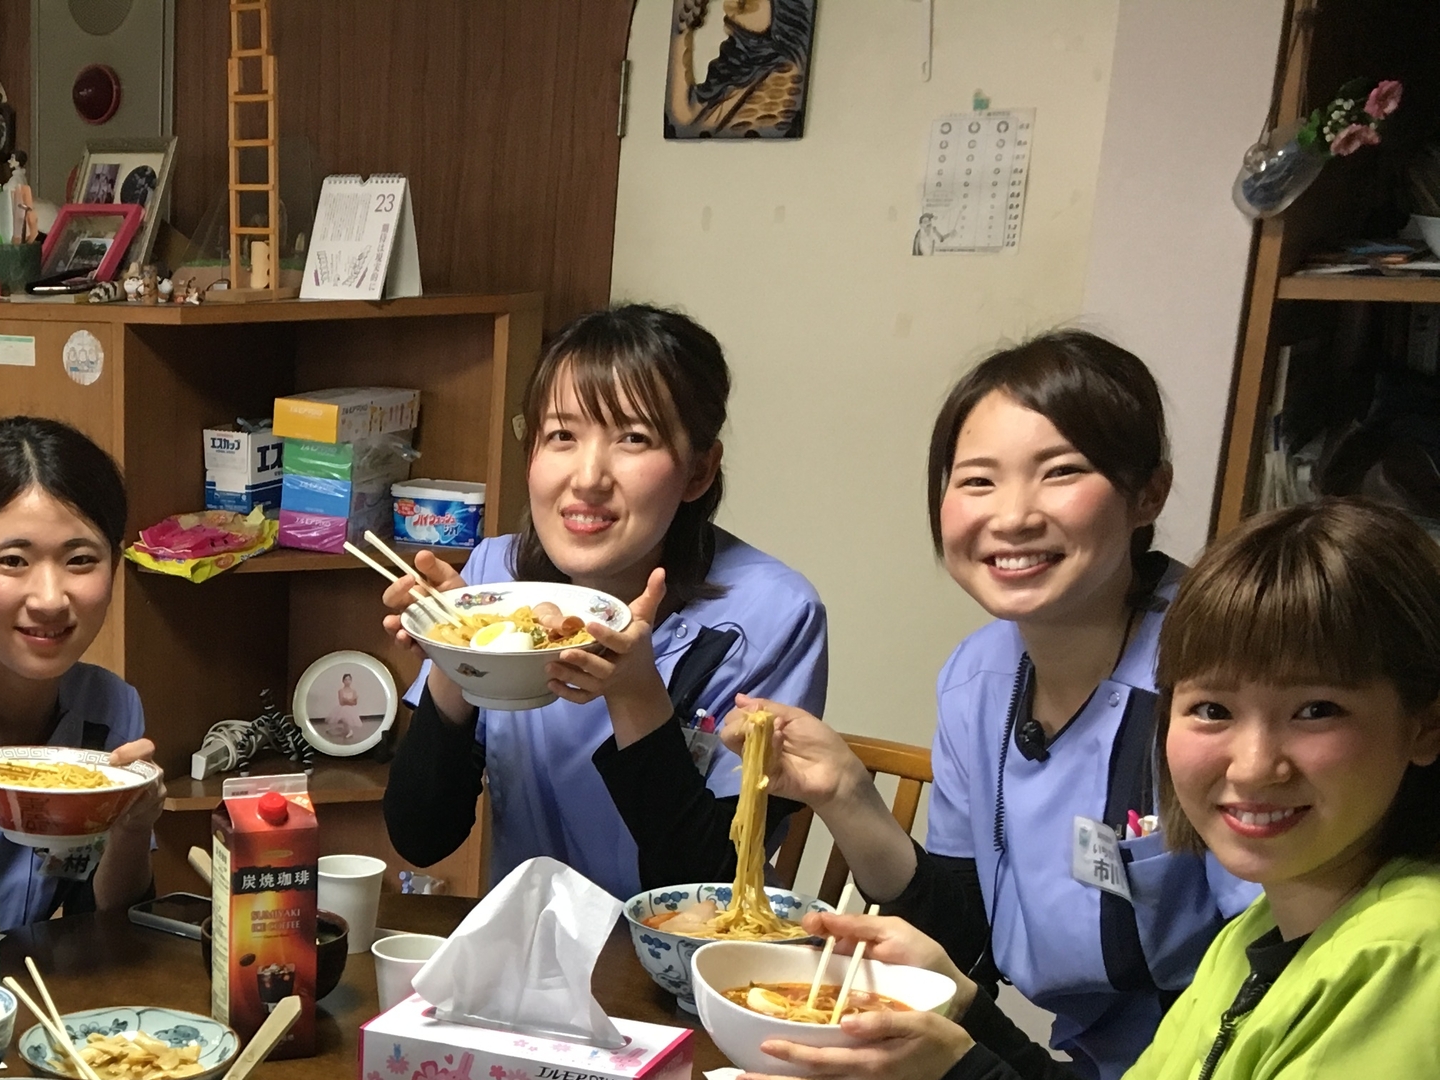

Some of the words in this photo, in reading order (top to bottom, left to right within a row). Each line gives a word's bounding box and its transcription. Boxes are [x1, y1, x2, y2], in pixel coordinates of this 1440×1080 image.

[374, 193, 395, 212] 23
[241, 869, 310, 891] 炭焼珈琲
[251, 908, 301, 921] SUMIYAKI
